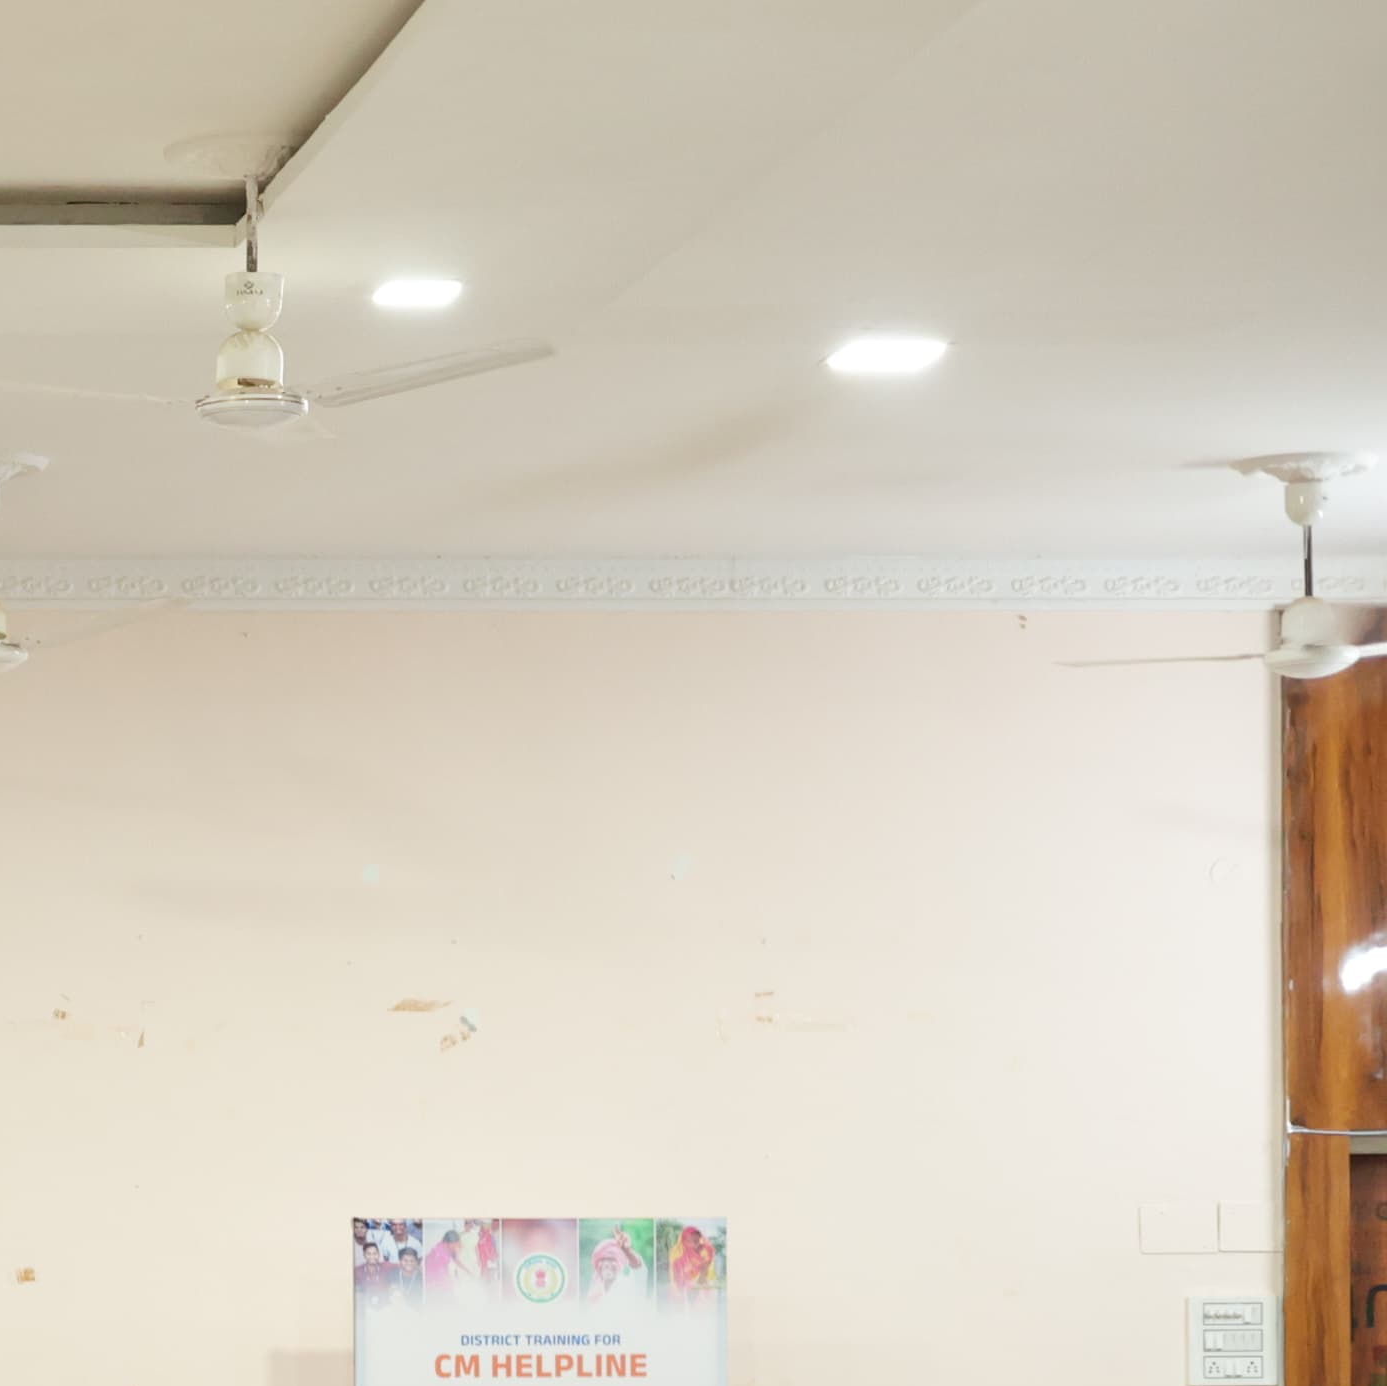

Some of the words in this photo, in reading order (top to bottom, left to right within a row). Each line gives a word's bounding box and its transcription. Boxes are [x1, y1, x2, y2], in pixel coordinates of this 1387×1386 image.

[460, 1334, 521, 1346] DISTRICT
[526, 1334, 591, 1346] TRAINING
[594, 1334, 621, 1345] FOR
[434, 1354, 481, 1378] CM
[491, 1353, 647, 1378] HELPLINE
